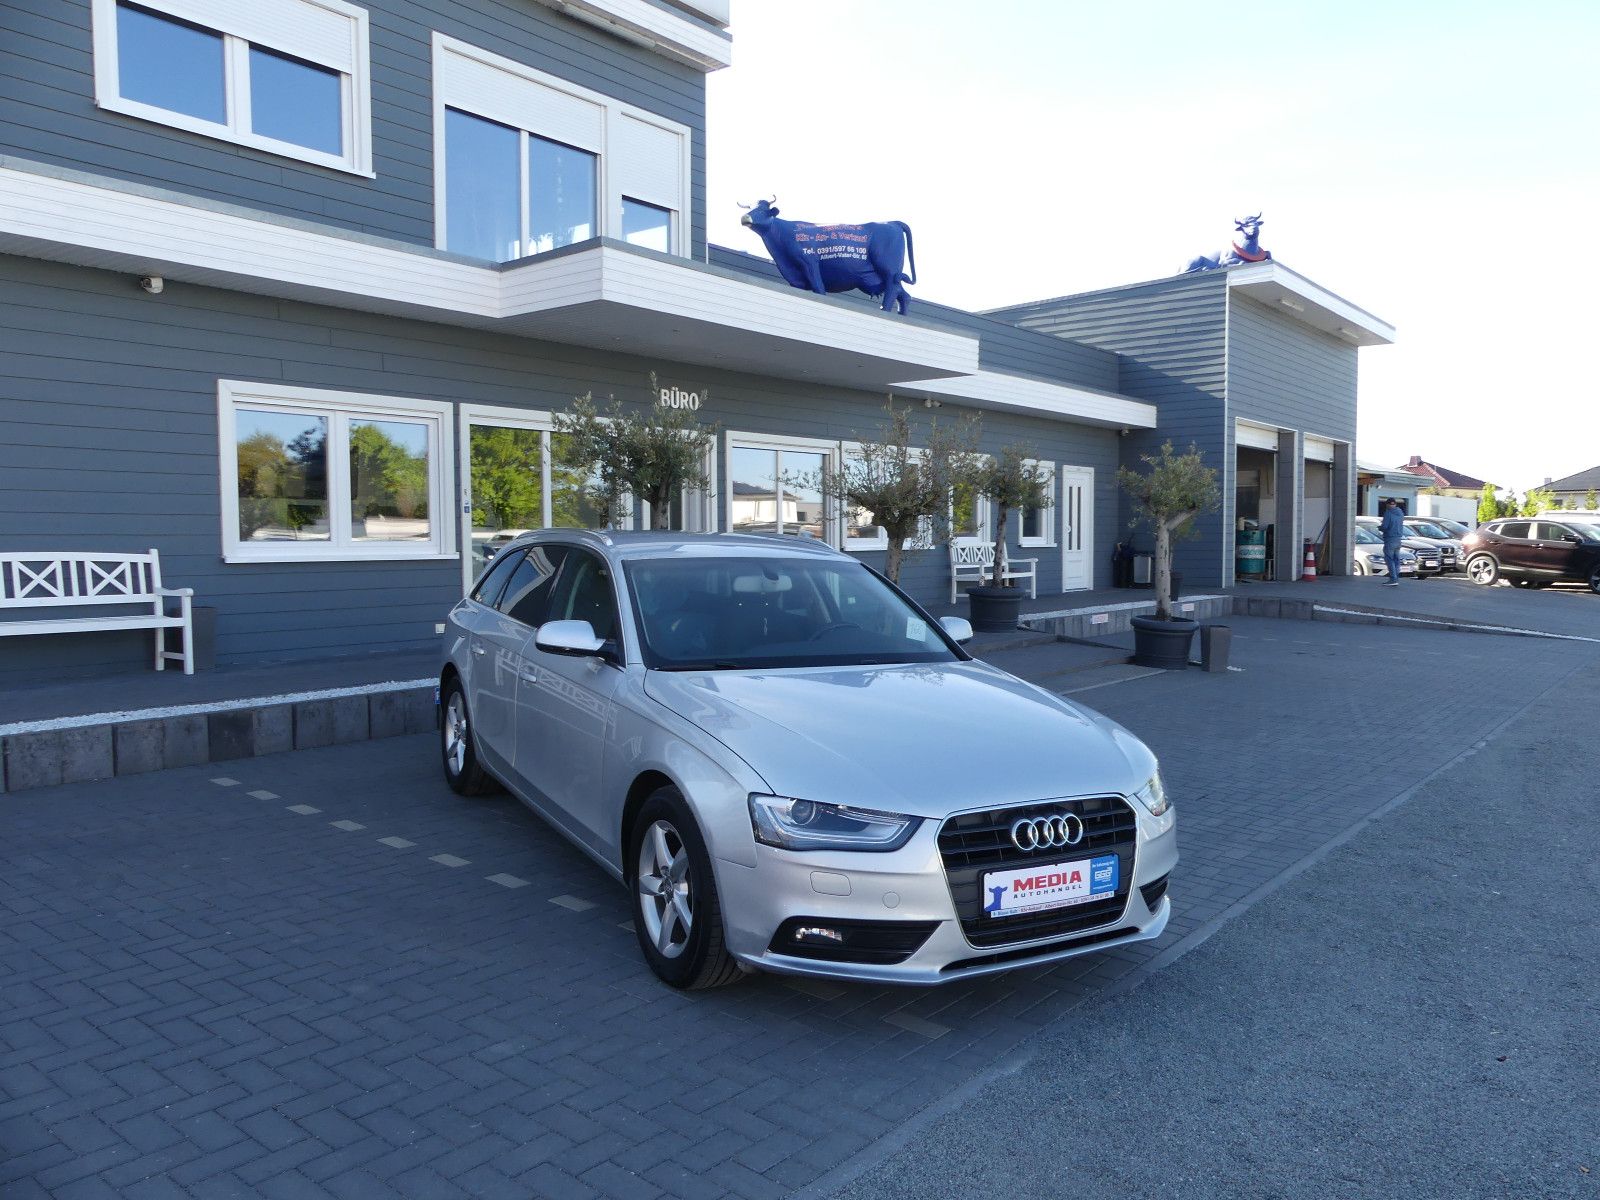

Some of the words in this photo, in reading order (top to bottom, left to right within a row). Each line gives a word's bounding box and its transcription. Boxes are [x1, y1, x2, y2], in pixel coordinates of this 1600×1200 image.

[817, 246, 846, 254] 0391/597
[661, 387, 699, 410] BÜRO
[1013, 871, 1082, 892] MEDIA
[1013, 885, 1083, 899] AUTOHANDEL
